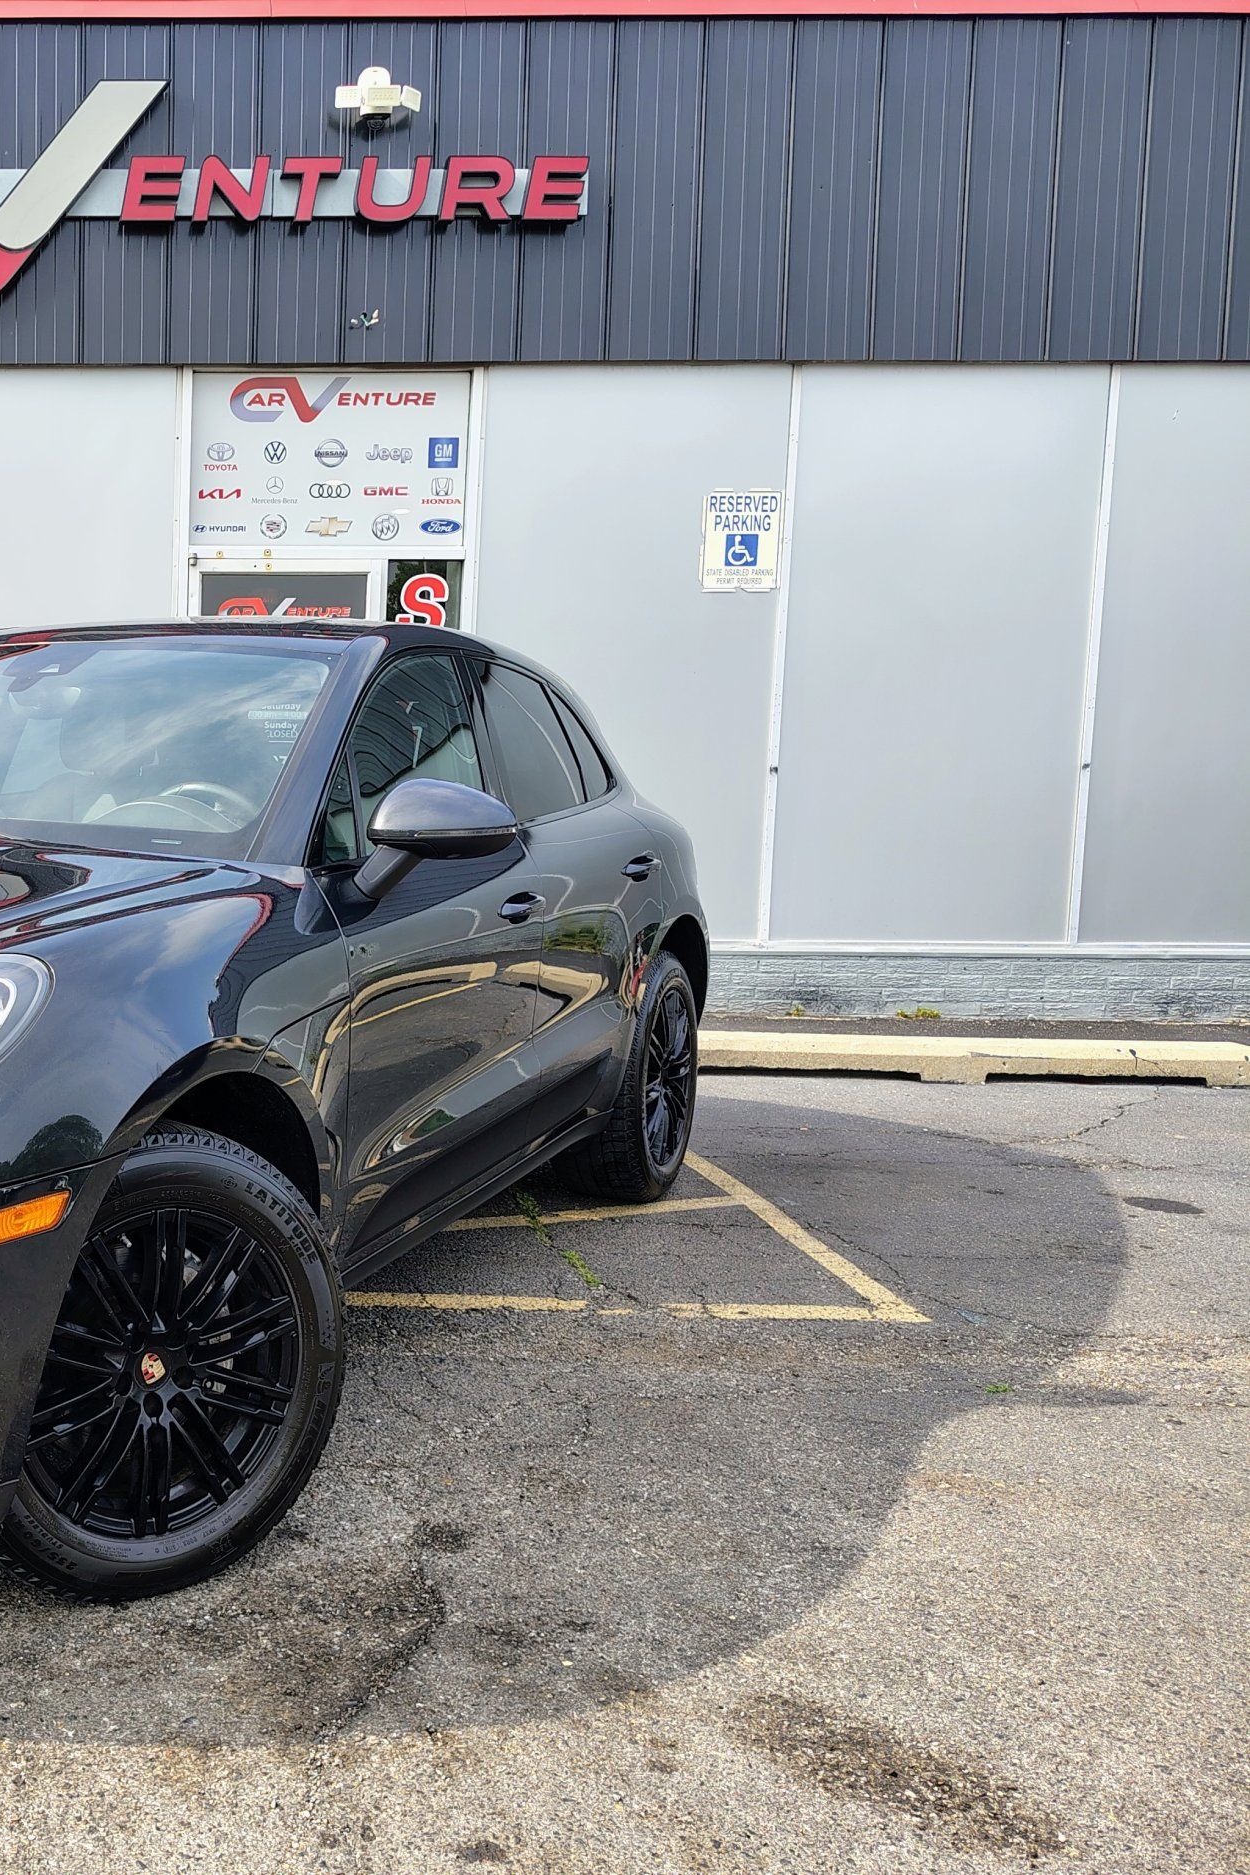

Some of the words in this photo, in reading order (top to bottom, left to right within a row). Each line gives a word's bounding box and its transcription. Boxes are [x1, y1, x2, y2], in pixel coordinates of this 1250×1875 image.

[365, 444, 414, 463] Jeep
[434, 444, 453, 458] GM
[363, 486, 409, 496] GMC
[709, 495, 778, 513] RESERVED
[427, 521, 454, 533] Ford
[713, 514, 772, 531] PARKING
[706, 568, 722, 576] STATE
[724, 568, 750, 576] DISABLED
[751, 568, 774, 577] PARKING
[716, 577, 735, 585] PERMIT
[264, 720, 298, 732] Sunday
[244, 1181, 318, 1265] LATITUDE
